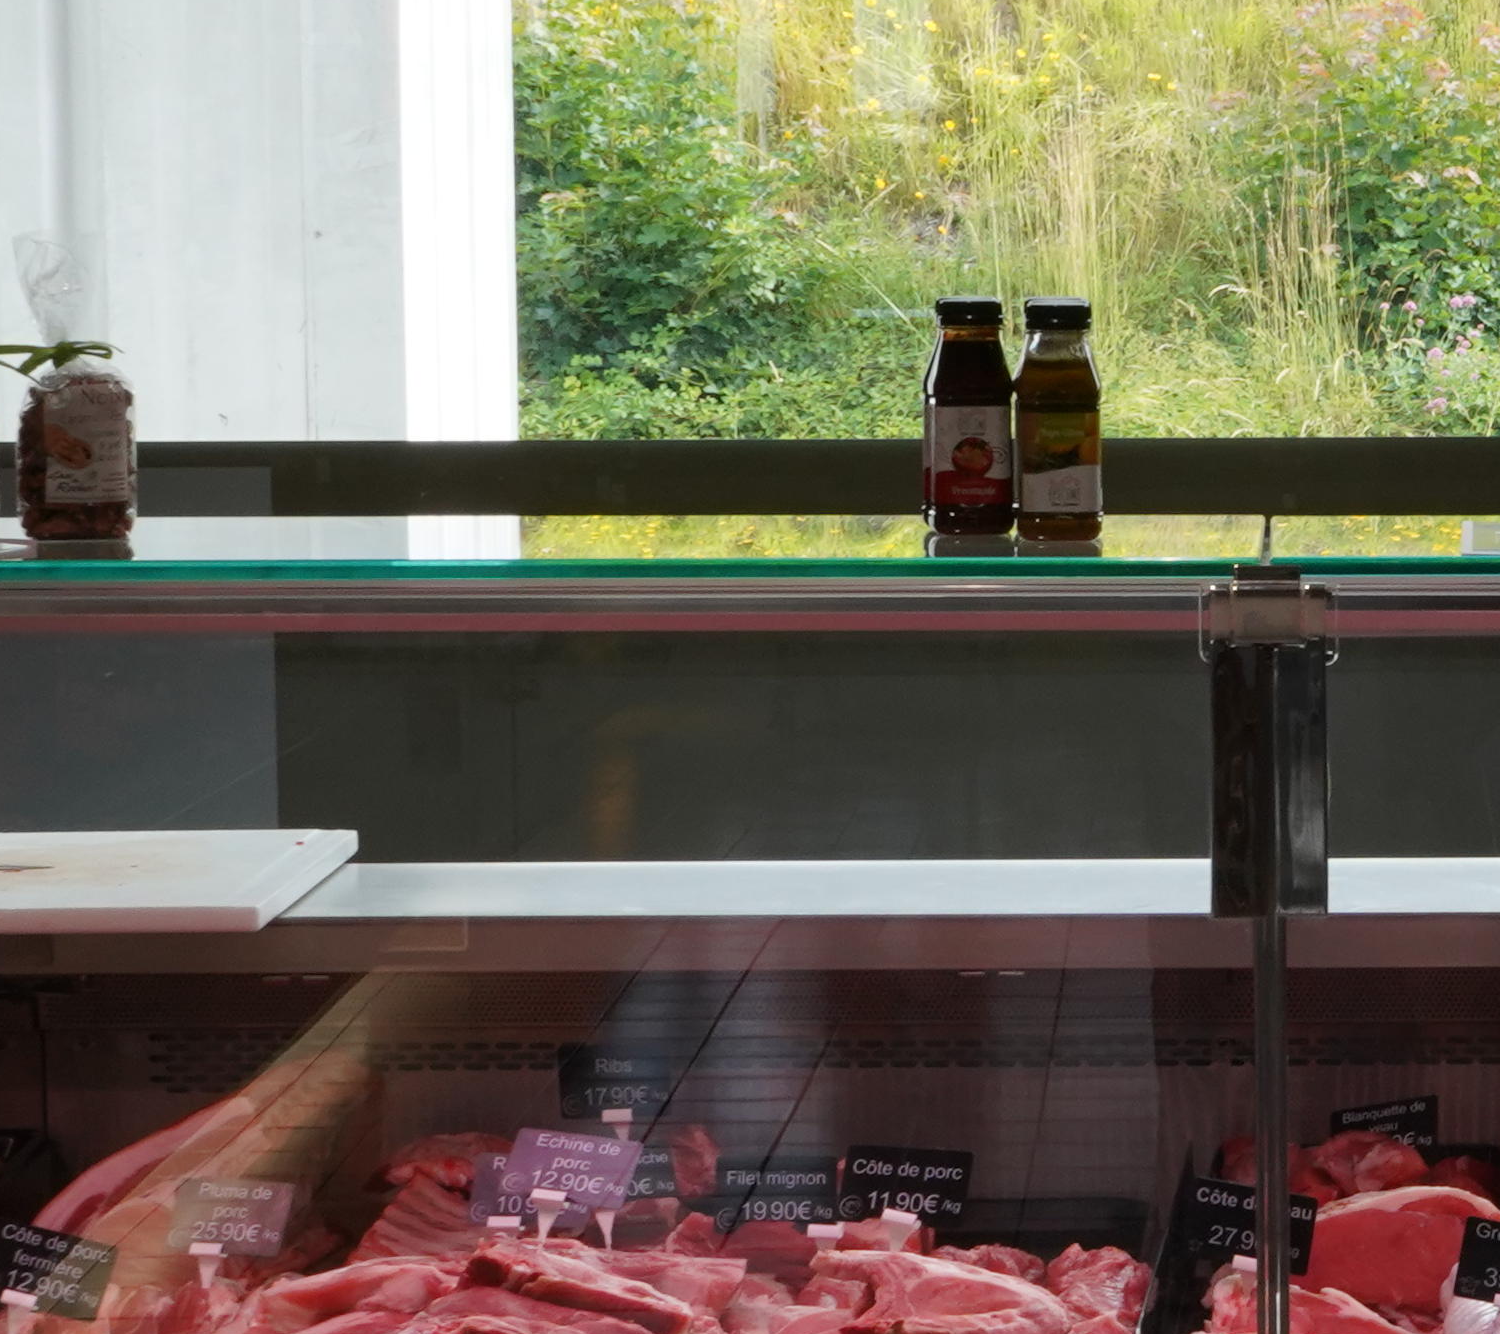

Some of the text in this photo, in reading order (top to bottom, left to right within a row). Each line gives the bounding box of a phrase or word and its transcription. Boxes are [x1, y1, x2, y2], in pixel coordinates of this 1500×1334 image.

[594, 1057, 633, 1074] Ribs
[1341, 1100, 1427, 1126] Blanquette de
[535, 1132, 622, 1157] Echine de
[551, 1155, 592, 1172] porc
[852, 1158, 964, 1181] Côte de porc
[198, 1180, 274, 1201] Pluma de
[726, 1169, 828, 1189] Filet mignon
[1195, 1186, 1239, 1209] Côte
[211, 1203, 249, 1222] porc
[1, 1222, 111, 1265] Côte de porc
[11, 1247, 84, 1280] fermière
